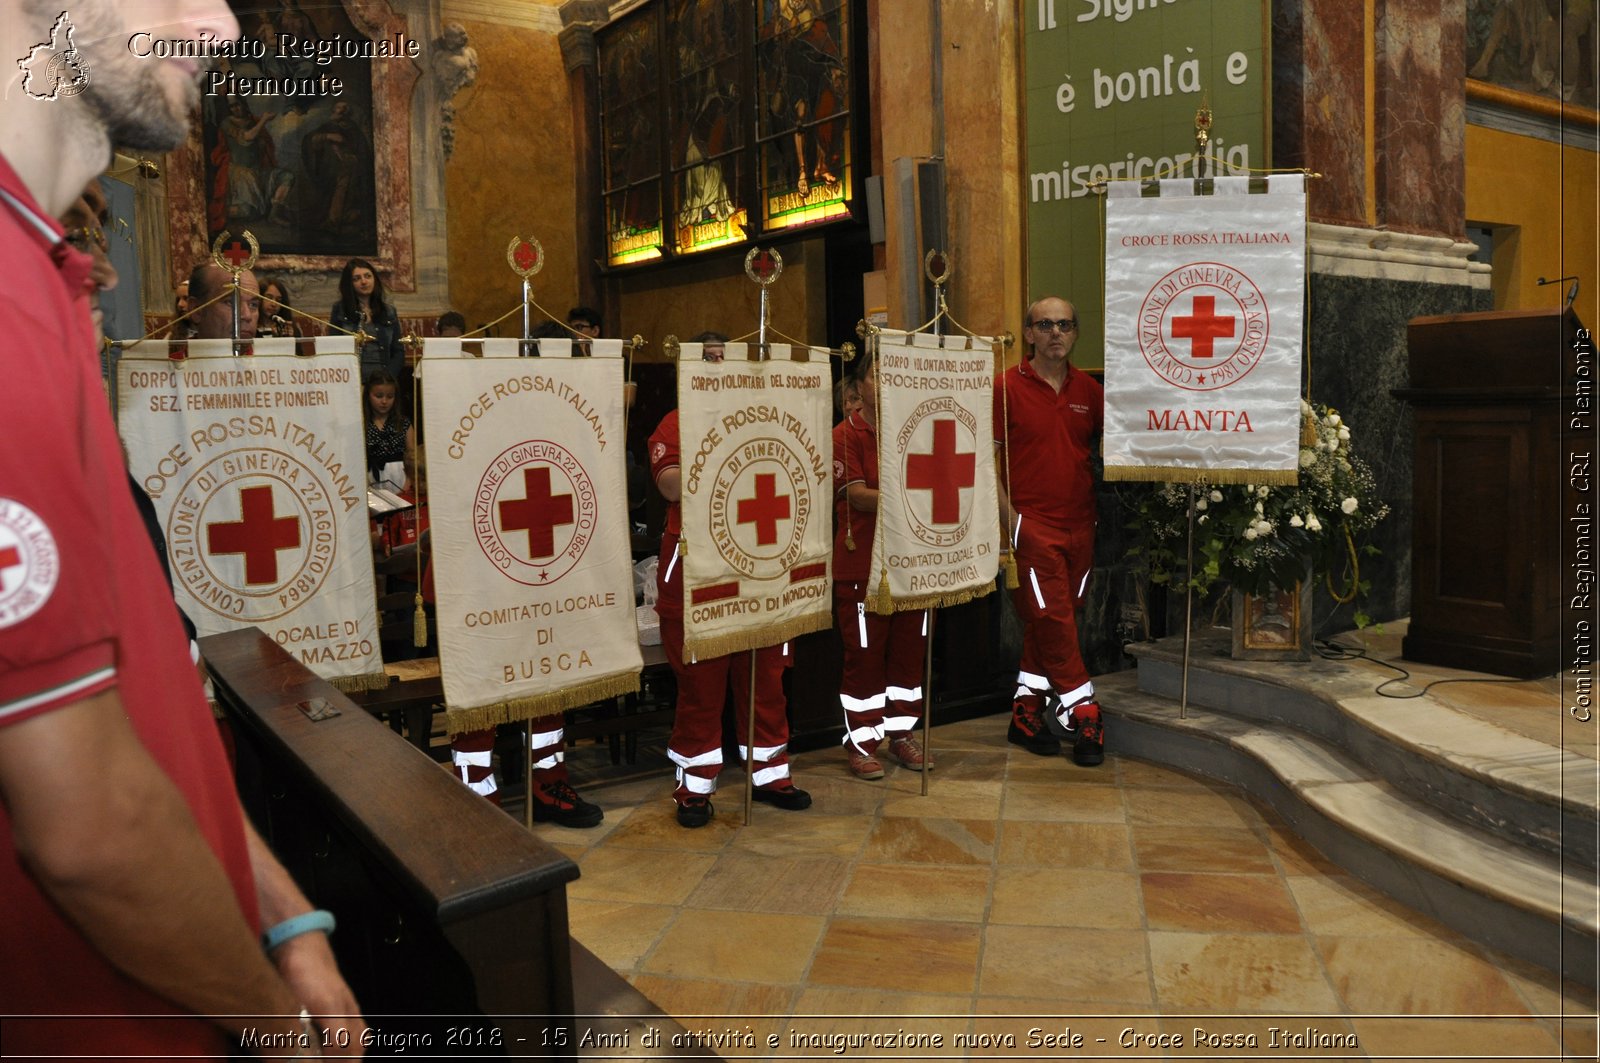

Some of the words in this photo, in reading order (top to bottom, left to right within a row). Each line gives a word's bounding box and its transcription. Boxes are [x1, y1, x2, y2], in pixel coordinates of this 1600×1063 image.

[1056, 73, 1076, 114] è
[1093, 47, 1202, 110] bontà
[1225, 51, 1249, 86] e
[1121, 234, 1169, 247] CROCE
[1173, 233, 1219, 246] ROSSA
[1222, 232, 1291, 245] ITALIANA
[1160, 278, 1179, 298] DI
[1178, 267, 1242, 294] GINEVRA
[1240, 291, 1259, 310] 22
[1143, 294, 1192, 384] CONVENZIONE
[1236, 311, 1264, 367] AGOSTO
[883, 355, 910, 370] CORPO
[1210, 361, 1240, 385] 1864
[129, 370, 177, 389] CORPO
[183, 369, 257, 389] VOLONTARI
[260, 369, 285, 386] DEL
[290, 368, 350, 385] SOCCORSO
[691, 375, 720, 392] CORPO
[770, 374, 785, 388] DEL
[149, 395, 182, 413] SEZ.
[274, 390, 329, 408] PIONIERI
[447, 392, 494, 460] CROCE
[493, 375, 556, 401] ROSSA
[558, 382, 607, 453] ITALIANA
[1146, 408, 1255, 433] MANTA
[511, 445, 562, 464] GINEVRA
[687, 427, 723, 495] CROCE
[721, 405, 780, 434] ROSSA
[782, 411, 827, 486] ITALIANA
[744, 442, 791, 468] GINEVRA
[144, 443, 193, 499] OCE
[191, 415, 277, 453] ROSSA
[283, 421, 361, 513] ITALIANA
[223, 453, 300, 484] GINEVRA
[496, 457, 512, 474] DI
[562, 457, 577, 473] 22
[728, 456, 742, 475] DI
[792, 466, 804, 486] 22
[197, 470, 218, 493] DI
[572, 472, 594, 530] AGOSTO
[476, 470, 512, 570] CONVENZIONE
[713, 477, 755, 574] CONVENZIONE
[313, 509, 332, 574] AGOSTO
[567, 532, 587, 560] 1864
[977, 542, 991, 556] DI
[173, 496, 245, 615] CONVENZIONE
[279, 574, 316, 609] 1864
[910, 565, 980, 592] RACCONIGI
[464, 602, 552, 628] COMITATO
[556, 592, 616, 614] LOCALE
[692, 599, 761, 624] COMITATO
[766, 597, 780, 612] DI
[269, 622, 339, 646] OCALE
[344, 620, 359, 636] DI
[536, 627, 554, 646] DI
[301, 639, 373, 665] MAZZO
[503, 649, 593, 684] BUSCA
